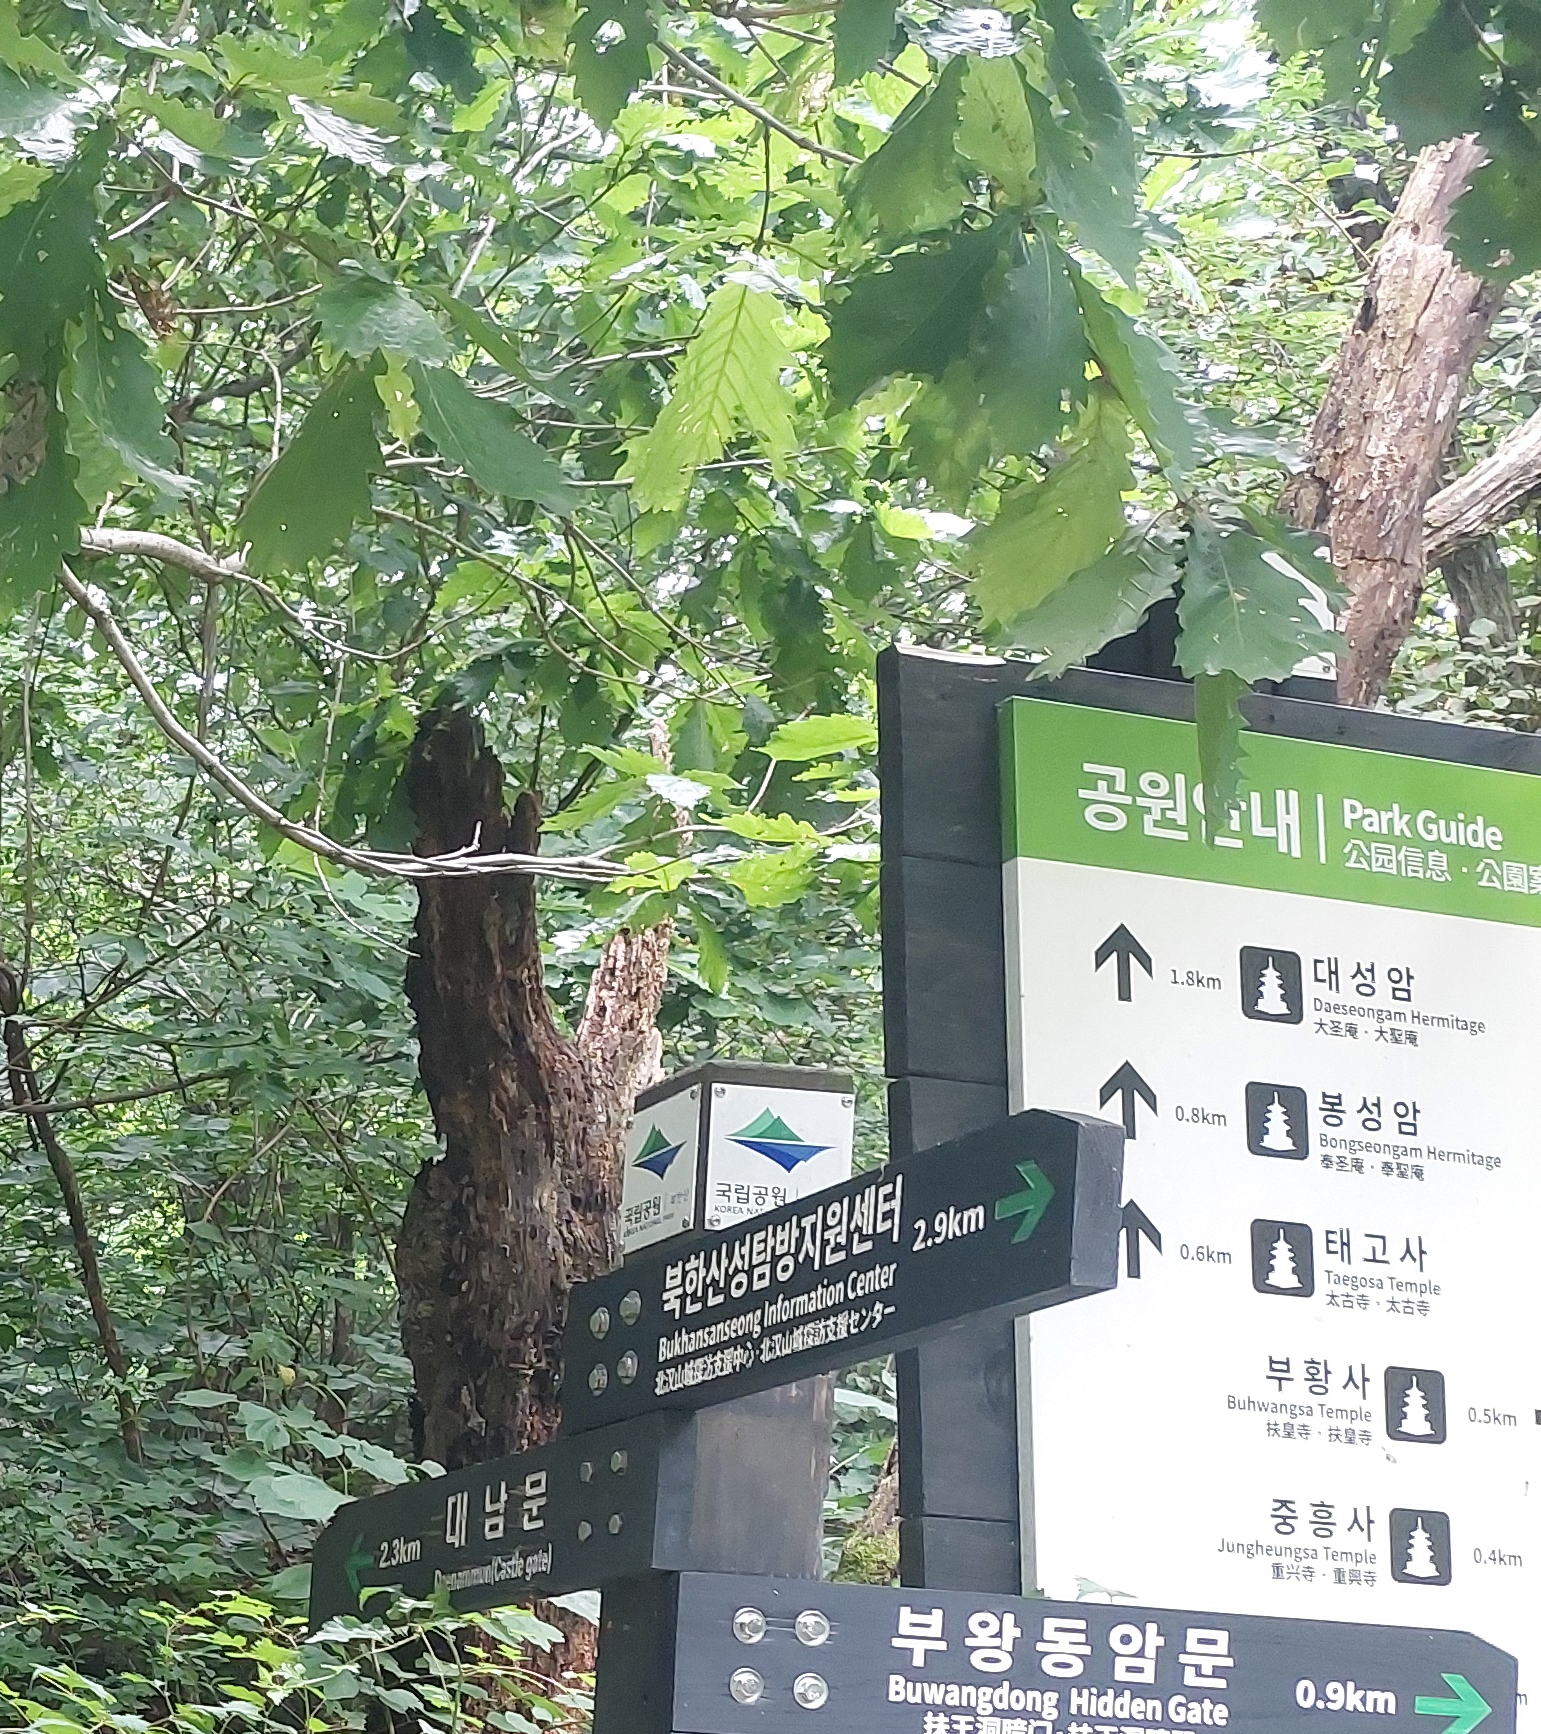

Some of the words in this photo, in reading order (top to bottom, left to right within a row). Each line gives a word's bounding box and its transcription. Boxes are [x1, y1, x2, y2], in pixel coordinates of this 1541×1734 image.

[1343, 798, 1414, 838] Park
[1416, 810, 1503, 851] Guide
[1170, 969, 1222, 991] 1.8km
[1313, 957, 1415, 1002] 대성암
[1313, 998, 1408, 1024] Daeseongam
[1411, 1010, 1486, 1035] Hermitage
[1175, 1106, 1227, 1127] 0.8km
[1319, 1092, 1421, 1137] 봉성암
[1320, 1134, 1423, 1160] Bongseongam
[1427, 1146, 1502, 1171] Hermitage
[714, 1182, 787, 1208] 국립공원
[912, 1201, 986, 1253] 2.9km
[660, 1174, 906, 1320] 북한산성탐방지원센터
[1180, 1244, 1232, 1265] 0.6km
[1325, 1228, 1428, 1273] 태고사
[1324, 1270, 1384, 1292] Taegosa
[1387, 1276, 1442, 1297] Temple
[658, 1306, 762, 1363] Bukhansanseong
[764, 1278, 846, 1330] Information
[847, 1262, 898, 1301] Center
[1266, 1355, 1371, 1401] 부황사
[1227, 1395, 1315, 1419] Buhwangsa
[1317, 1404, 1373, 1424] Temple
[1468, 1407, 1518, 1427] 0.5km
[445, 1470, 549, 1548] 대남문
[1270, 1498, 1376, 1543] 중흥사
[379, 1536, 422, 1570] 2.3km
[1217, 1538, 1320, 1560] Jungheungsa
[1323, 1546, 1377, 1567] Temple
[1473, 1548, 1523, 1568] 0.4km
[889, 1606, 1237, 1690] 부왕동암문
[888, 1674, 1059, 1722] Buwangdong
[1070, 1683, 1165, 1724] Hidden
[1167, 1694, 1230, 1728] Gate
[1296, 1678, 1397, 1717] 0.9km
